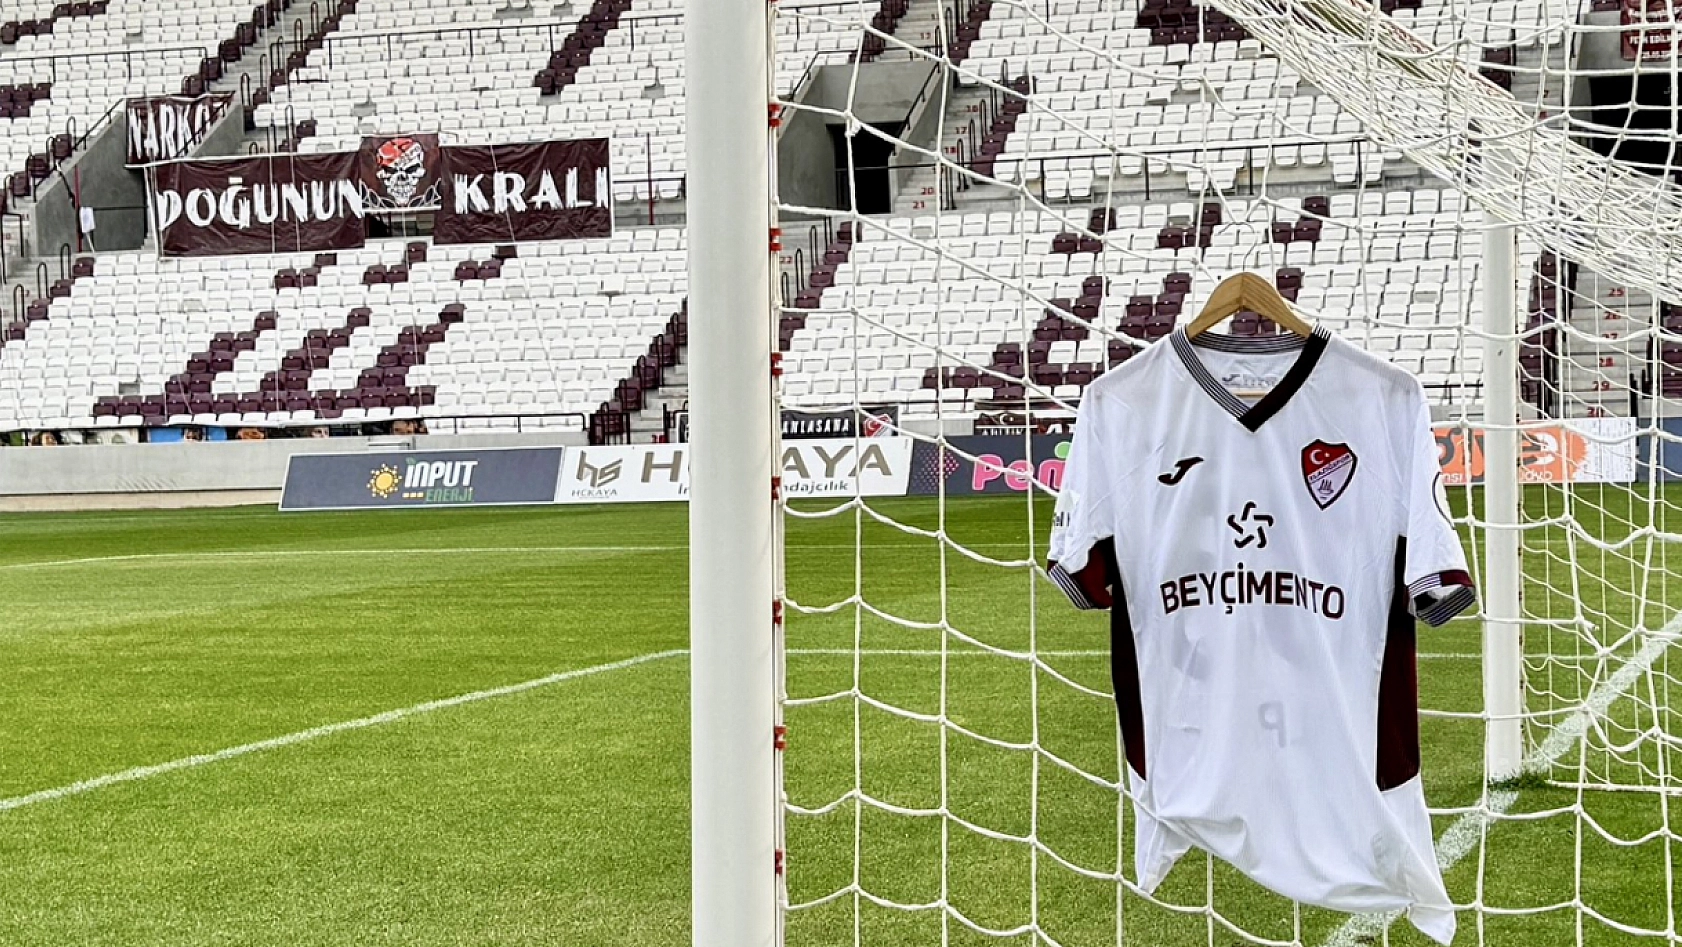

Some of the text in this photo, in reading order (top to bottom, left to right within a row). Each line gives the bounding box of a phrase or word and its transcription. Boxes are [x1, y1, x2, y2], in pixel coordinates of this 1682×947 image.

[156, 166, 609, 231] DOĞUNUN KRALI
[1609, 287, 1625, 297] 25
[1160, 562, 1345, 619] BEYÇİMENTO
